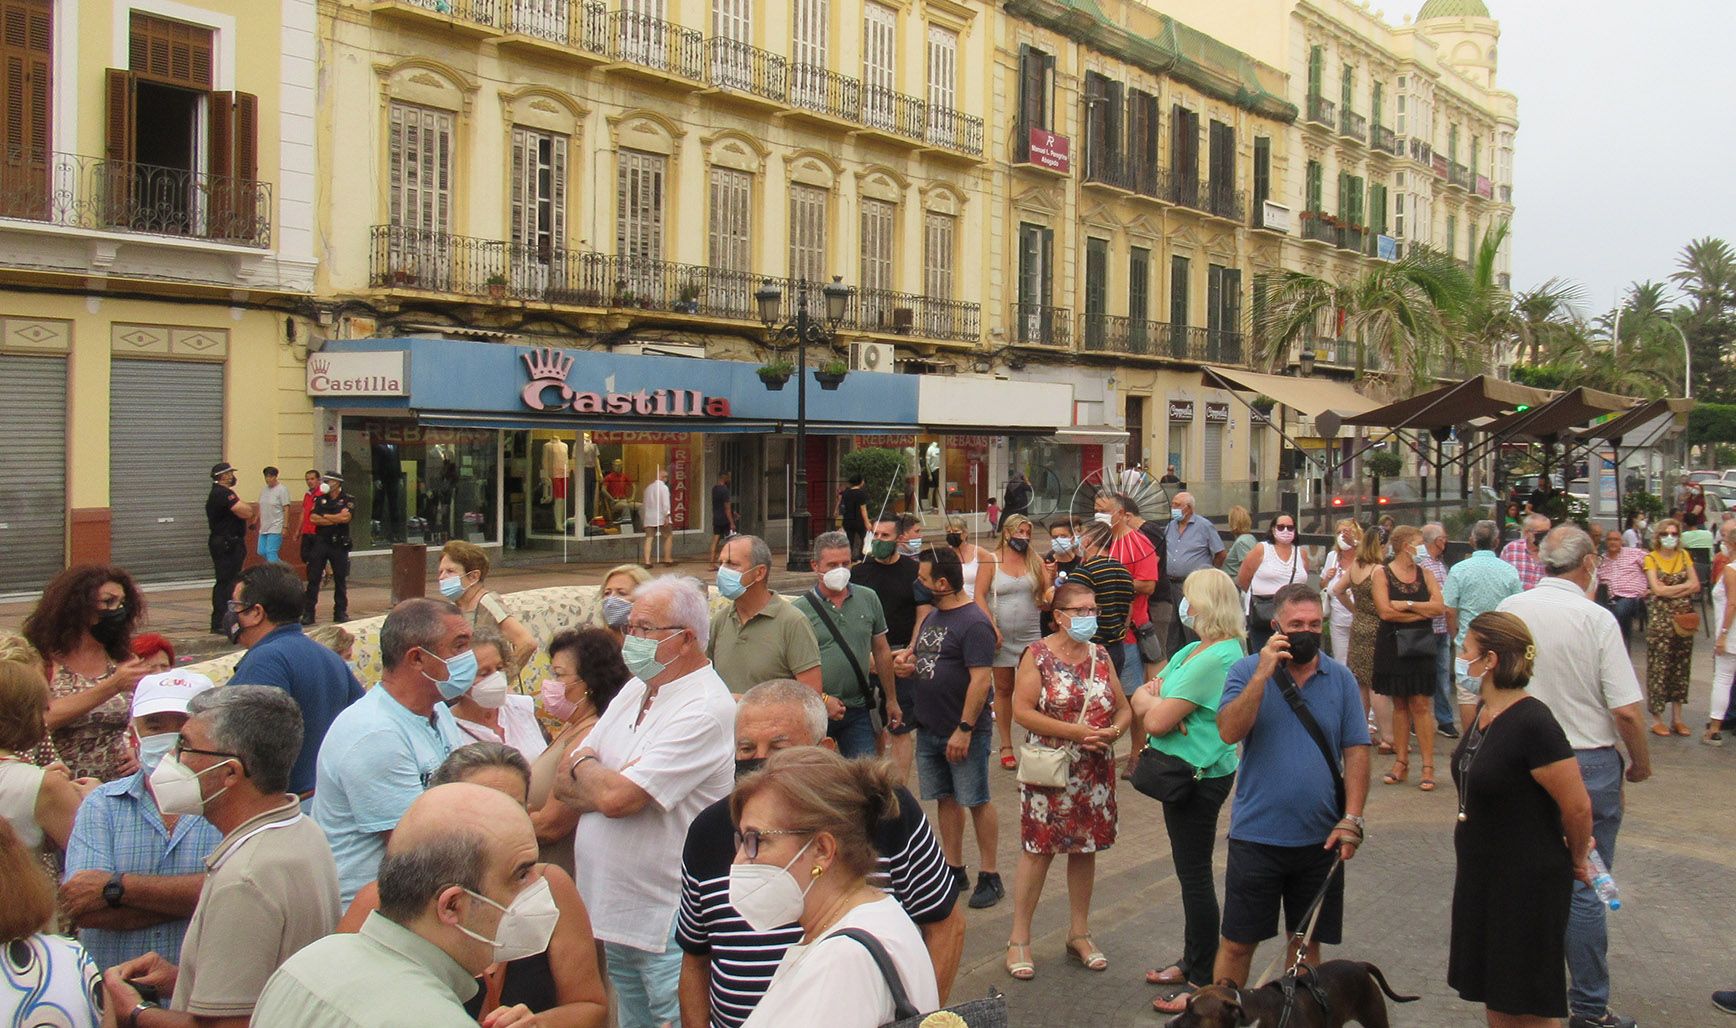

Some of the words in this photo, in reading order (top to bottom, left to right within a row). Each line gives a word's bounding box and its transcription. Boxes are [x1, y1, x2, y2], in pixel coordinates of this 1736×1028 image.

[1041, 156, 1059, 167] Abogado
[310, 375, 400, 392] Castilla
[521, 378, 733, 417] Castilla
[862, 435, 914, 446] REBAJAS
[946, 435, 988, 448] REBAJAS
[674, 449, 687, 522] REBAJAS
